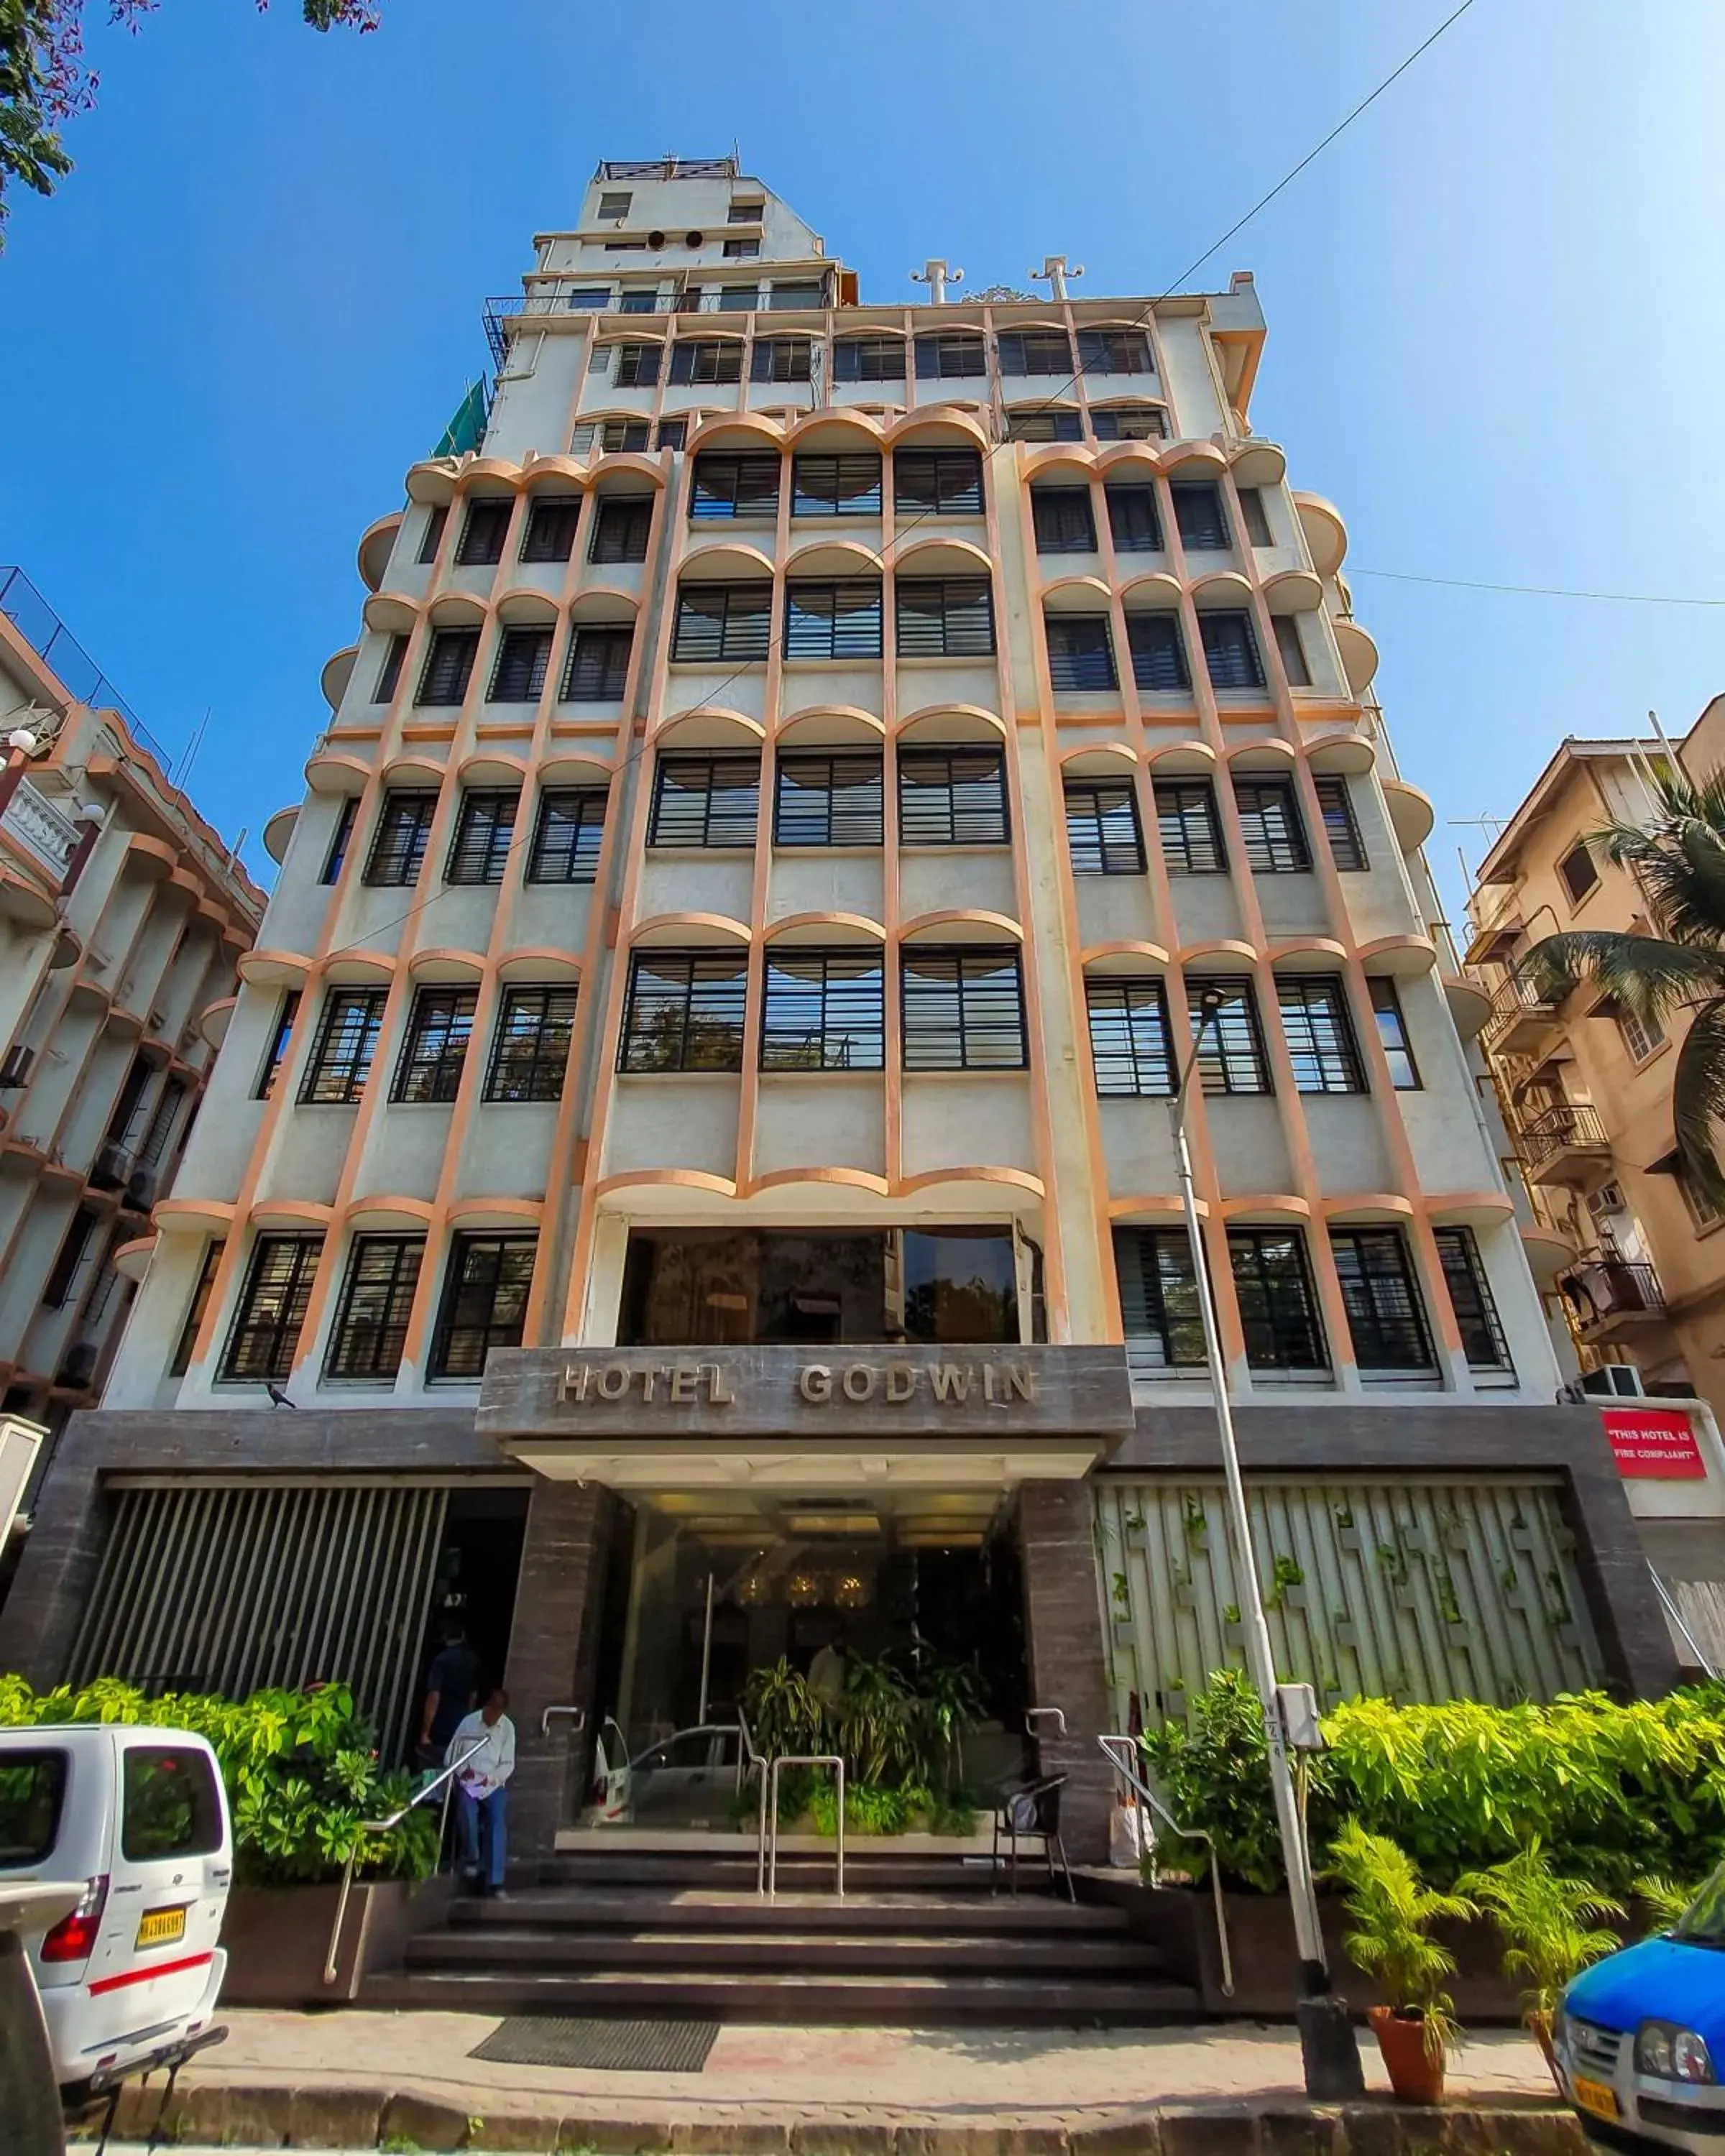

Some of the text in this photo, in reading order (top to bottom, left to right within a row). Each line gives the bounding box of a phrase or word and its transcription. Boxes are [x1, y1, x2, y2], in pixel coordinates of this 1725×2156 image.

[557, 1363, 1034, 1402] HOTEL GODWIN
[1640, 1430, 1676, 1441] HOTEL
[1678, 1431, 1690, 1441] IS
[1614, 1449, 1636, 1458] FIRE
